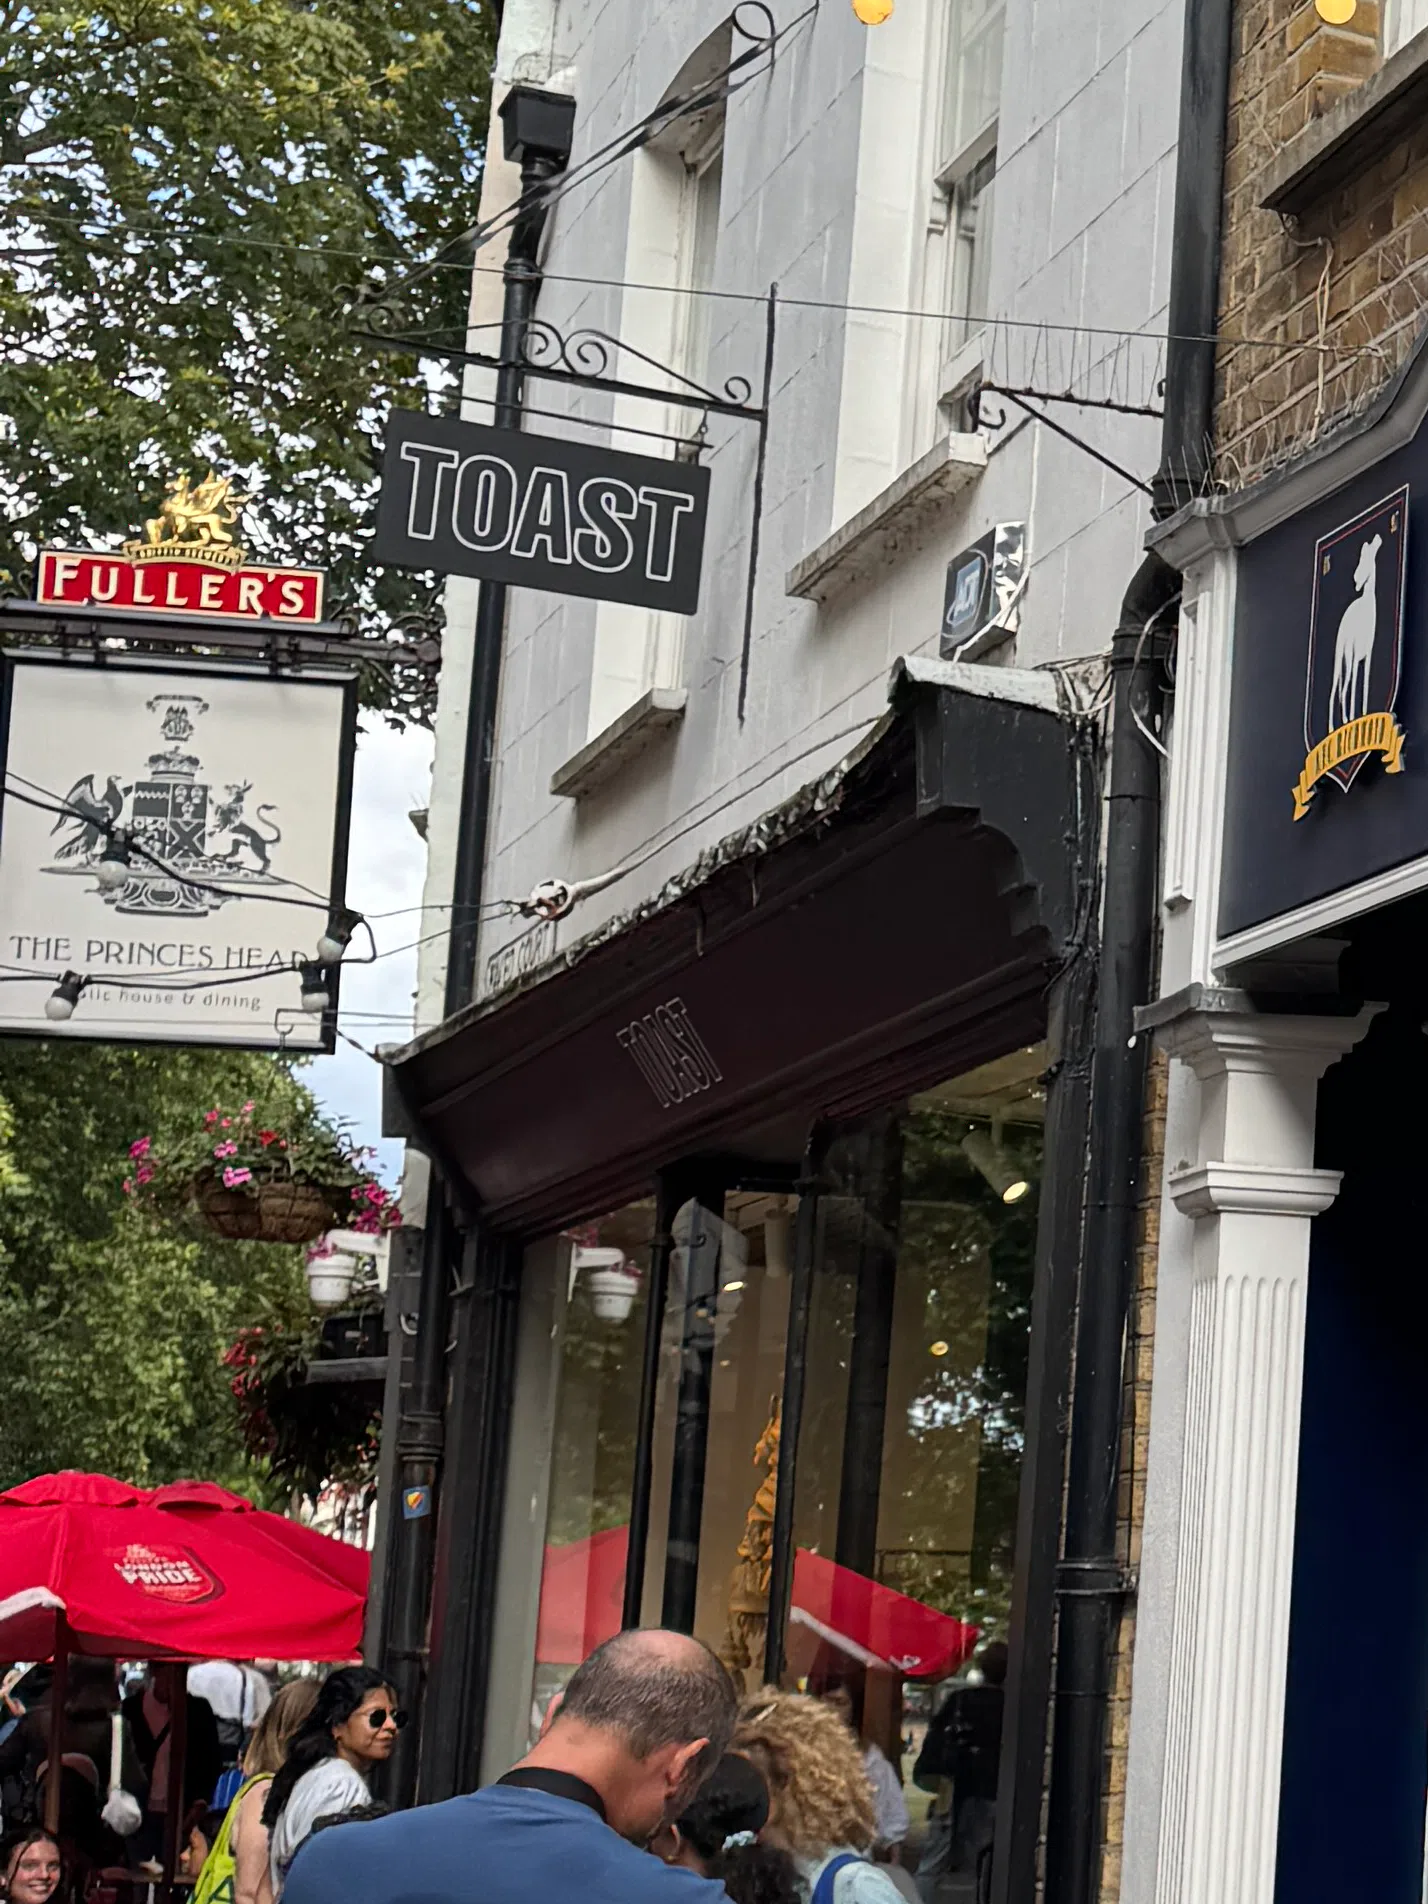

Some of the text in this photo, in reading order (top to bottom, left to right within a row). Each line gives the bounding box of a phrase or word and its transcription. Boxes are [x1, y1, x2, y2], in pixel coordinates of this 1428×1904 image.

[400, 440, 695, 583] TOAST
[52, 556, 305, 616] FULLER'S
[9, 935, 311, 970] THE PRINCES HEAD
[119, 986, 182, 1005] house
[202, 989, 261, 1011] dining
[616, 997, 724, 1109] TOAST
